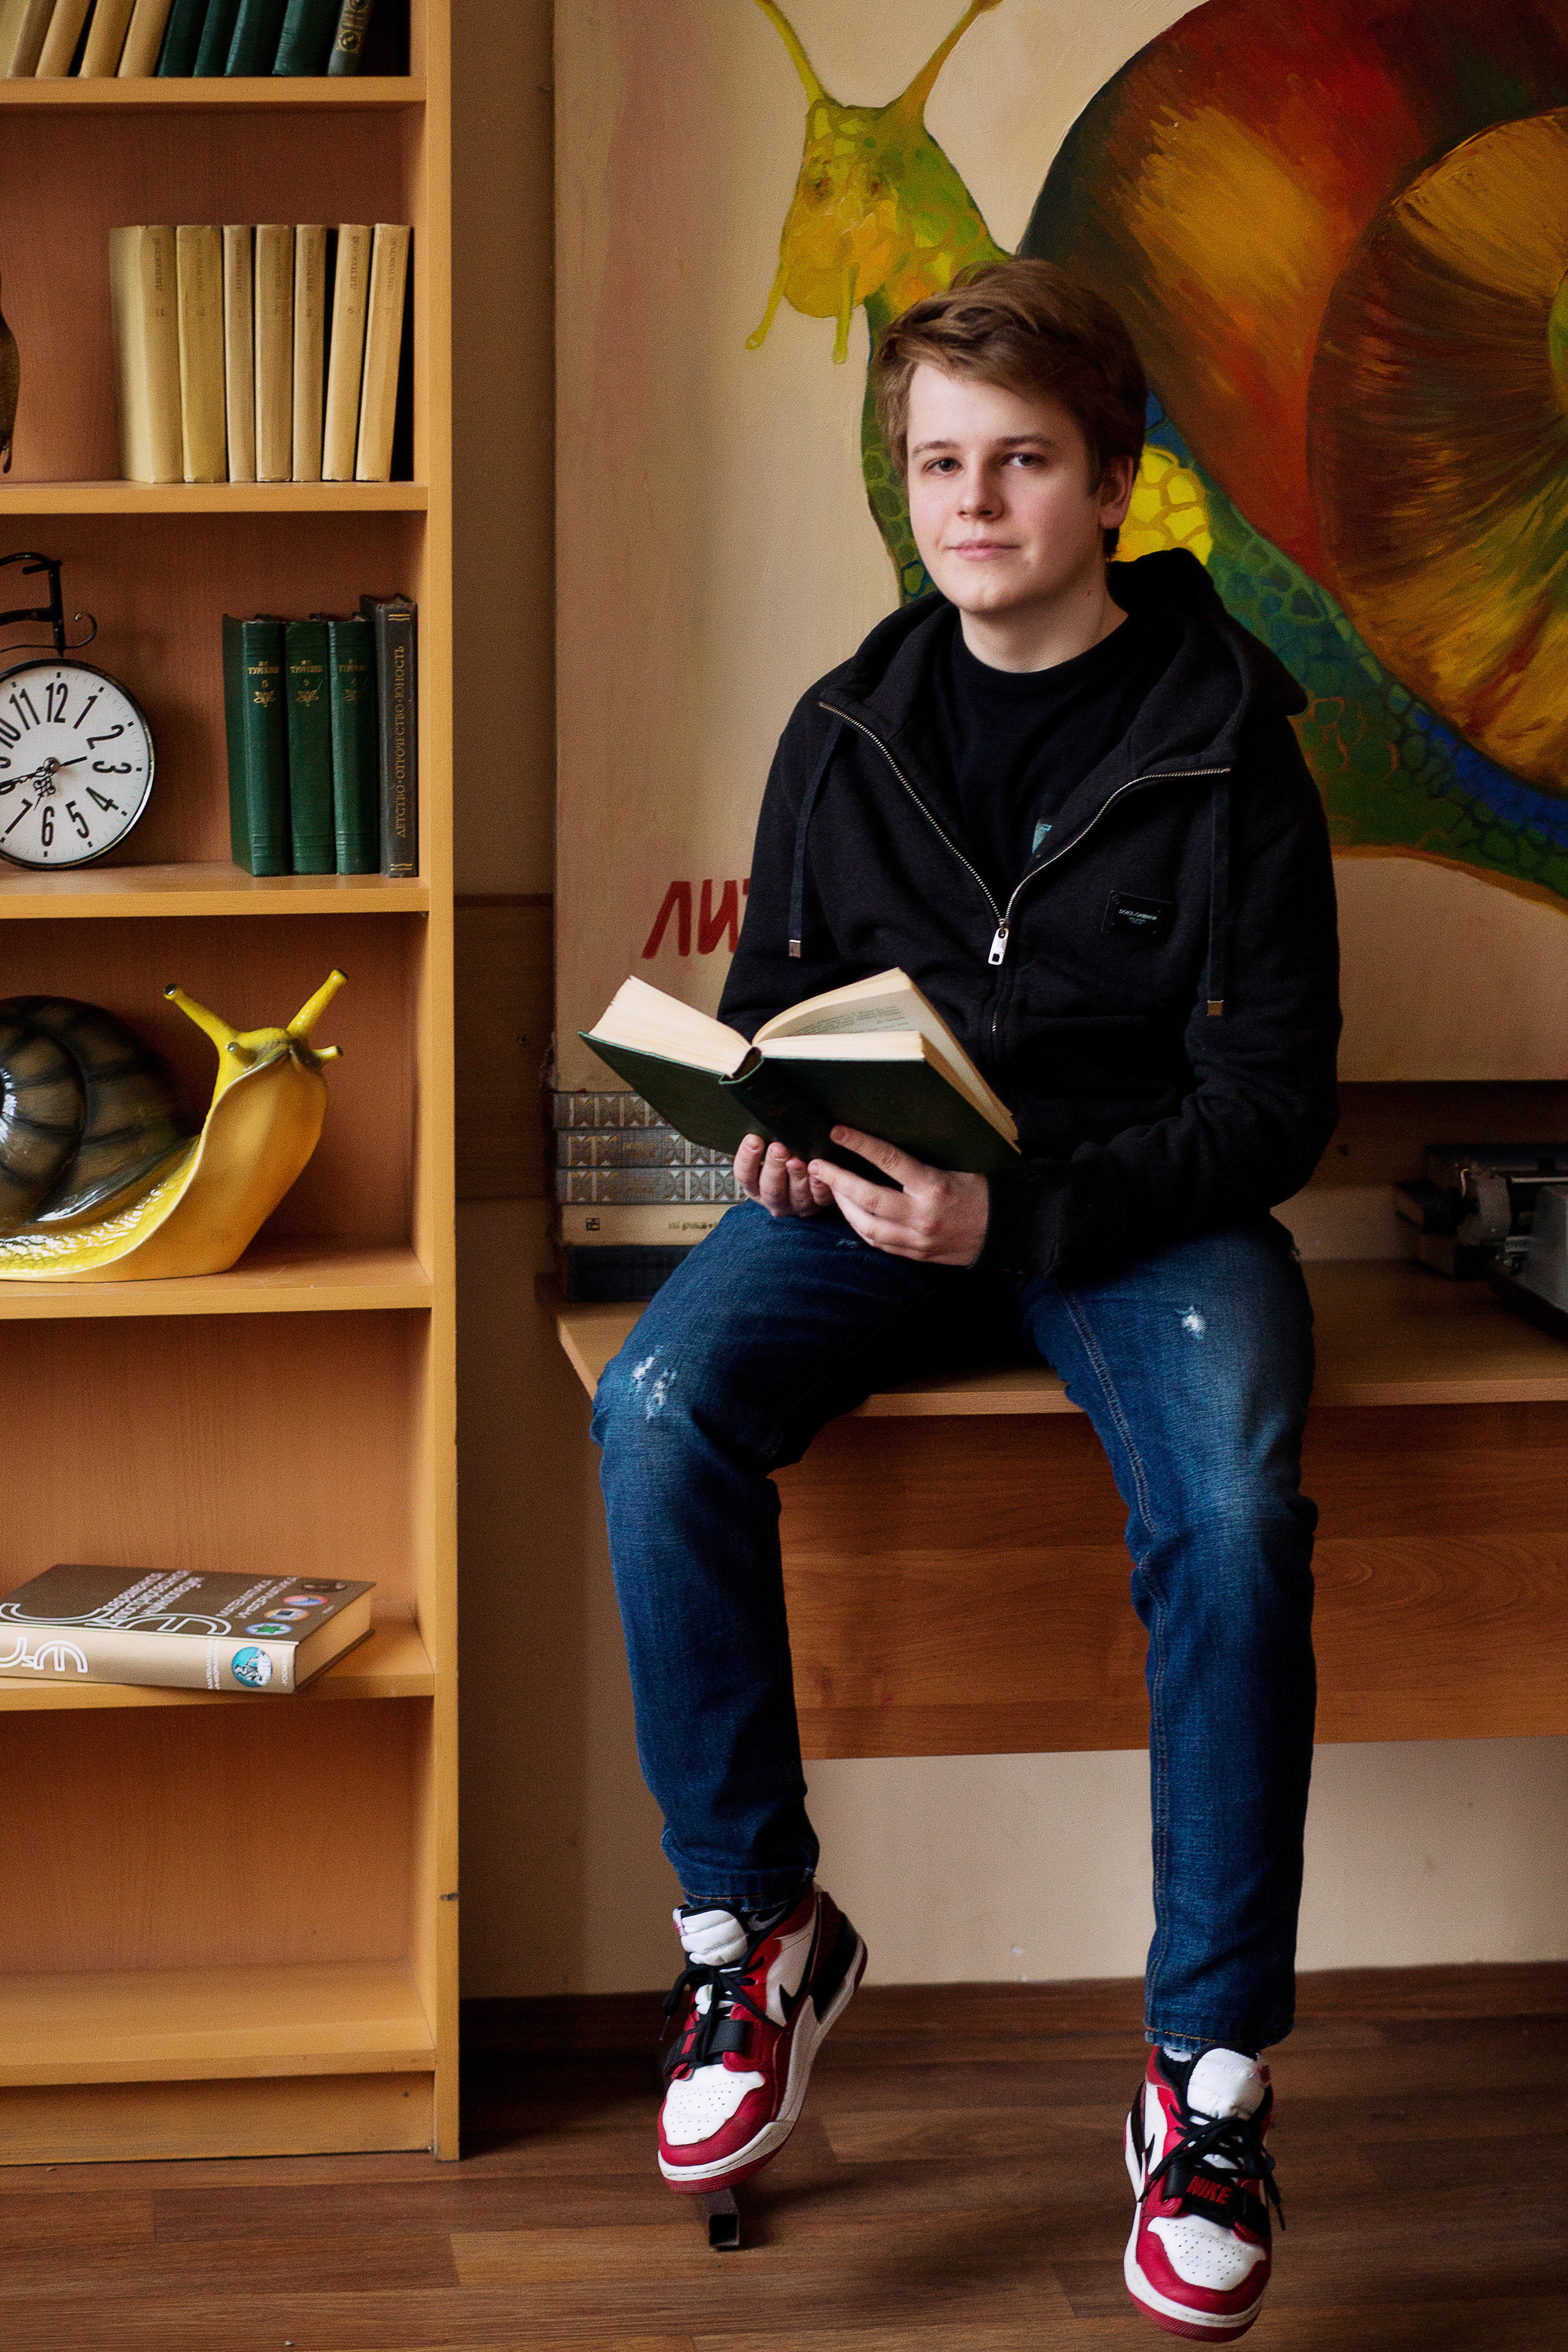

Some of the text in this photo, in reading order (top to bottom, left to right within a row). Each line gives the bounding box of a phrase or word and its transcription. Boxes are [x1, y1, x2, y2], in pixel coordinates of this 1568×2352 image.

[9, 688, 41, 730] 11
[45, 682, 69, 723] 12
[73, 695, 99, 729] 1
[86, 725, 125, 750] 2
[92, 761, 132, 774] 3
[5, 798, 33, 835] 7
[85, 786, 119, 812] 4
[42, 806, 55, 847] 6
[65, 800, 90, 839] 5
[642, 878, 750, 959] ЛИ
[1186, 2176, 1232, 2204] NIKE
